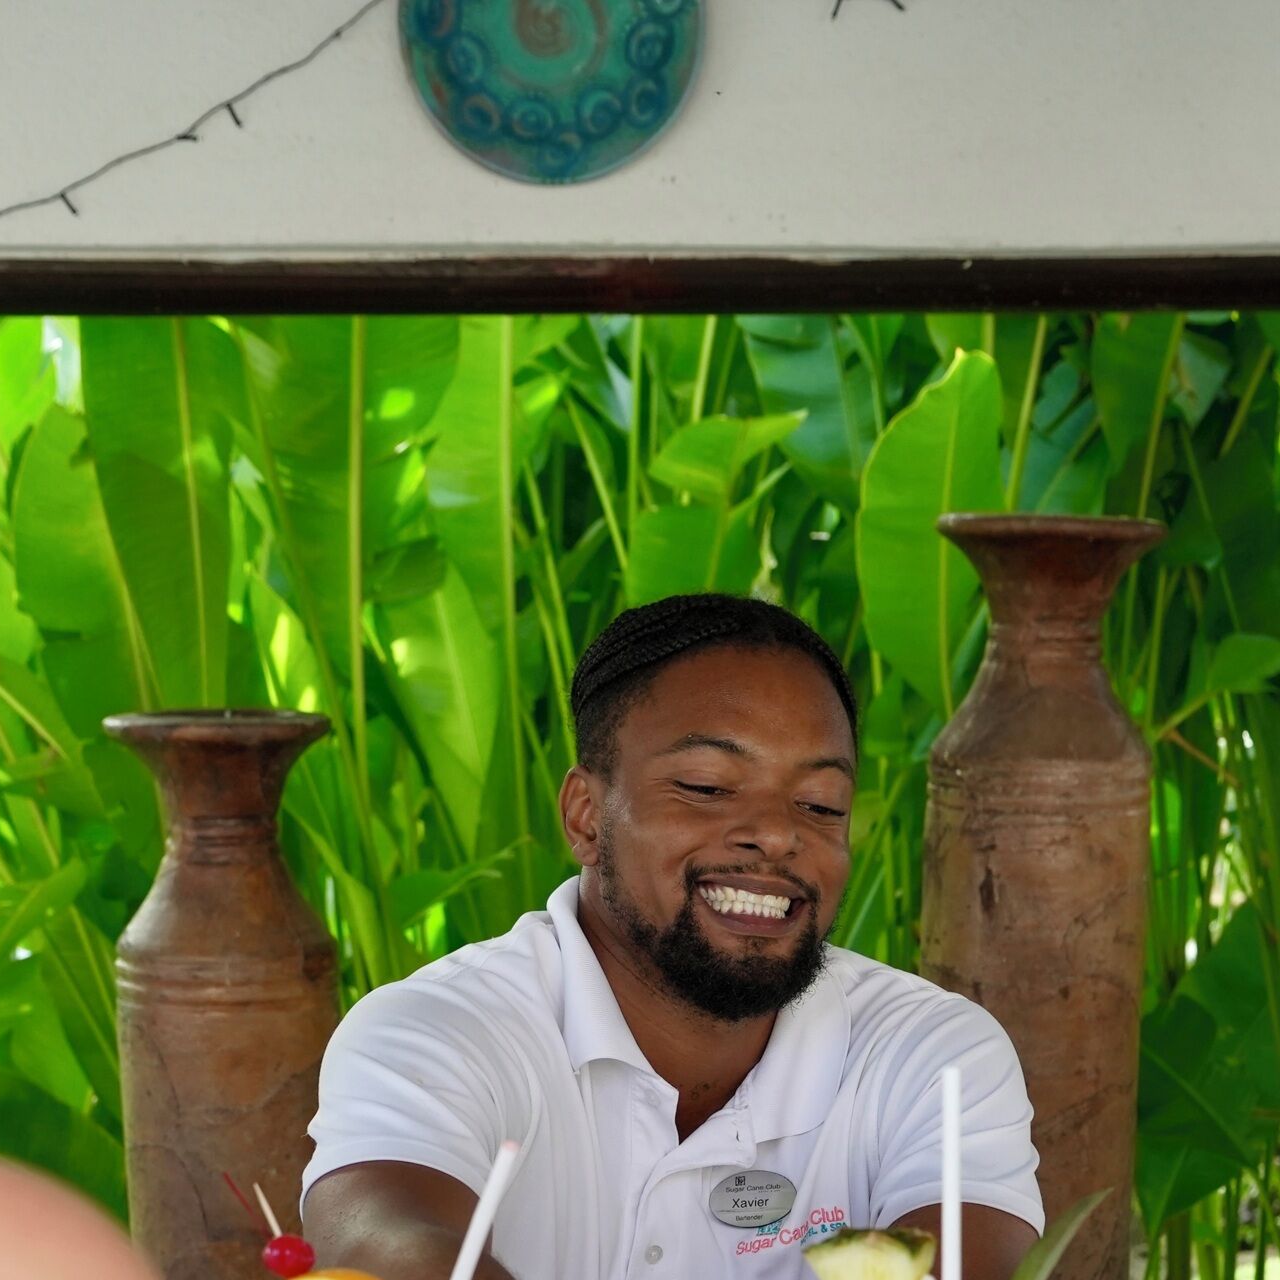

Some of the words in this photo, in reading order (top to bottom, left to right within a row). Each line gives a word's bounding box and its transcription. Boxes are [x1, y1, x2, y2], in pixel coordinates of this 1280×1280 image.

[731, 1197, 769, 1209] Xavier
[736, 1235, 777, 1255] Sugar
[810, 1206, 844, 1225] Club
[820, 1224, 828, 1233] &
